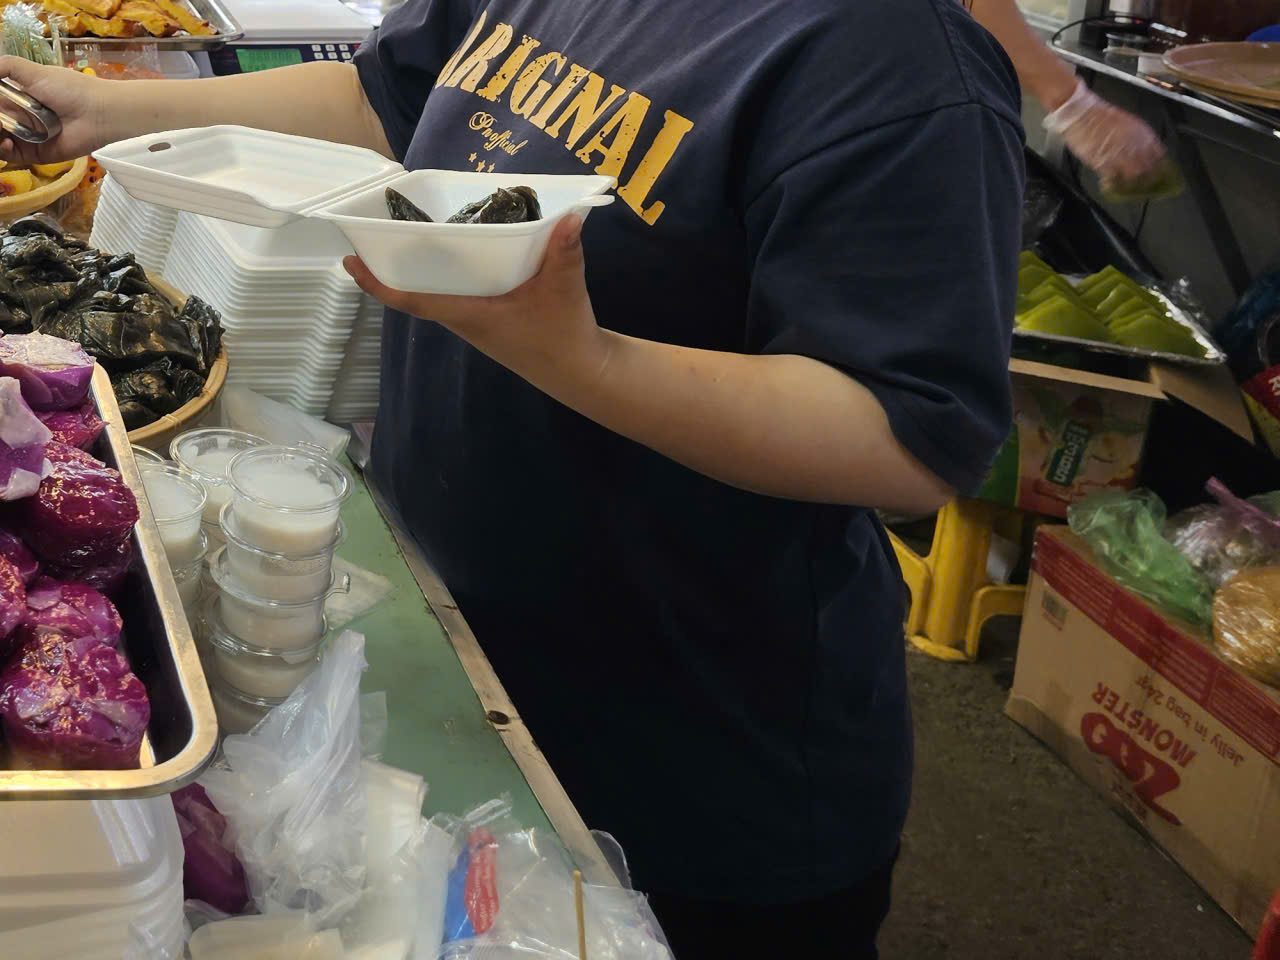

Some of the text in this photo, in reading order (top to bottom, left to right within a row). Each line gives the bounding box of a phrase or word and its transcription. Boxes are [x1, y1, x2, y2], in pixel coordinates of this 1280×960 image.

[1091, 681, 1199, 769] MONSTER
[1166, 696, 1193, 728] bag
[1194, 719, 1209, 741] in
[1210, 733, 1245, 767] Jelly
